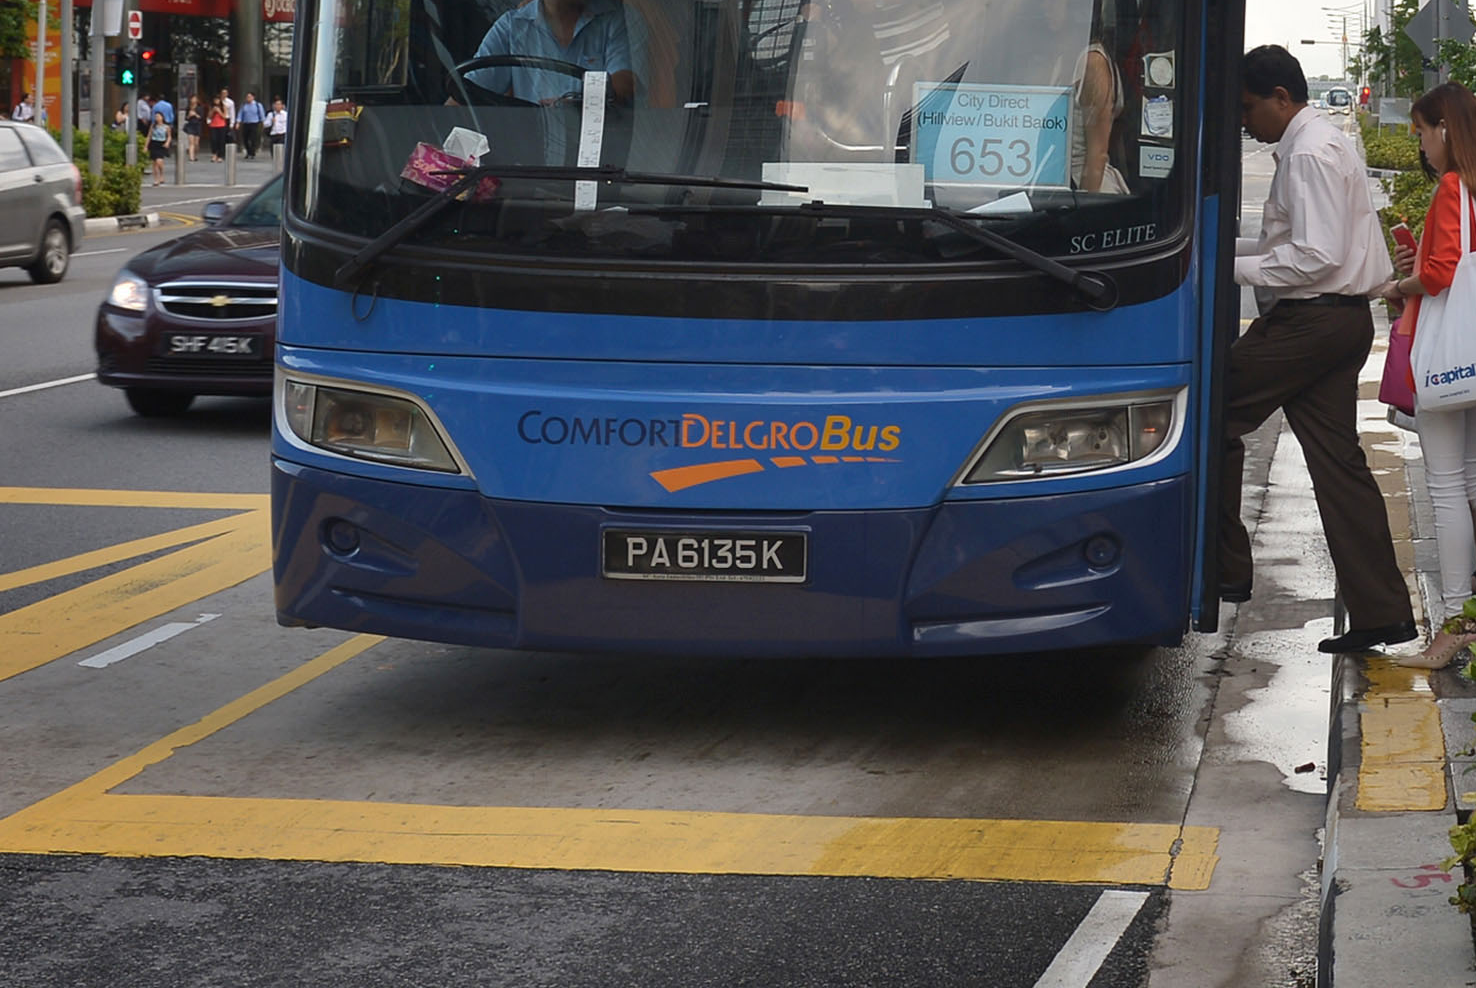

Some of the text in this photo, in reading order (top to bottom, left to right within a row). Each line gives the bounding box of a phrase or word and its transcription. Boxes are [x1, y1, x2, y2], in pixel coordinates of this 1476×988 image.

[957, 92, 1030, 111] City Direct
[1022, 113, 1069, 132] Batok)
[950, 136, 1032, 177] 653
[1069, 222, 1157, 254] SC ELITE
[170, 335, 208, 352] SHF
[626, 536, 784, 570] PA6135K
